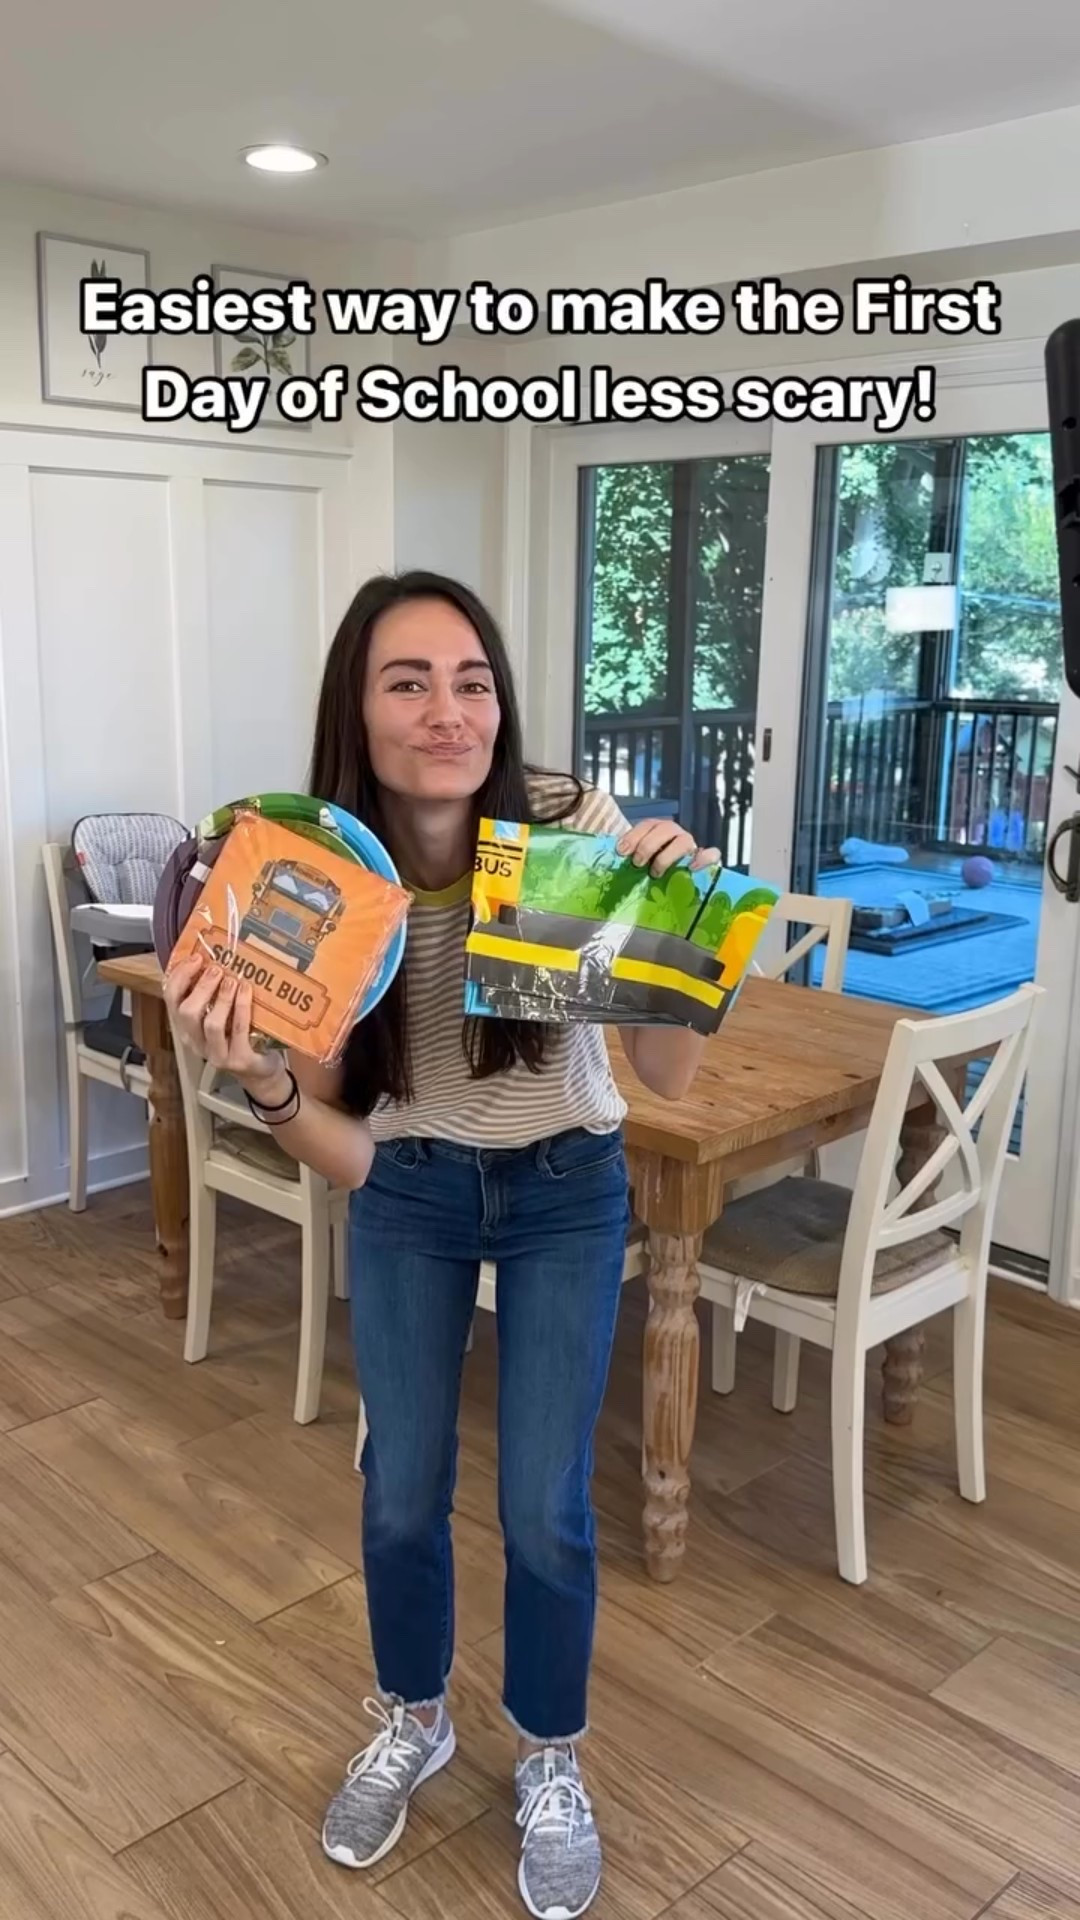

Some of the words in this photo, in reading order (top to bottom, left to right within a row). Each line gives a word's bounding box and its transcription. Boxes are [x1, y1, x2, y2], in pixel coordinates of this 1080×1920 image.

[473, 856, 513, 878] BUS
[210, 944, 275, 993] SCHOOL
[276, 980, 314, 1013] BUS
